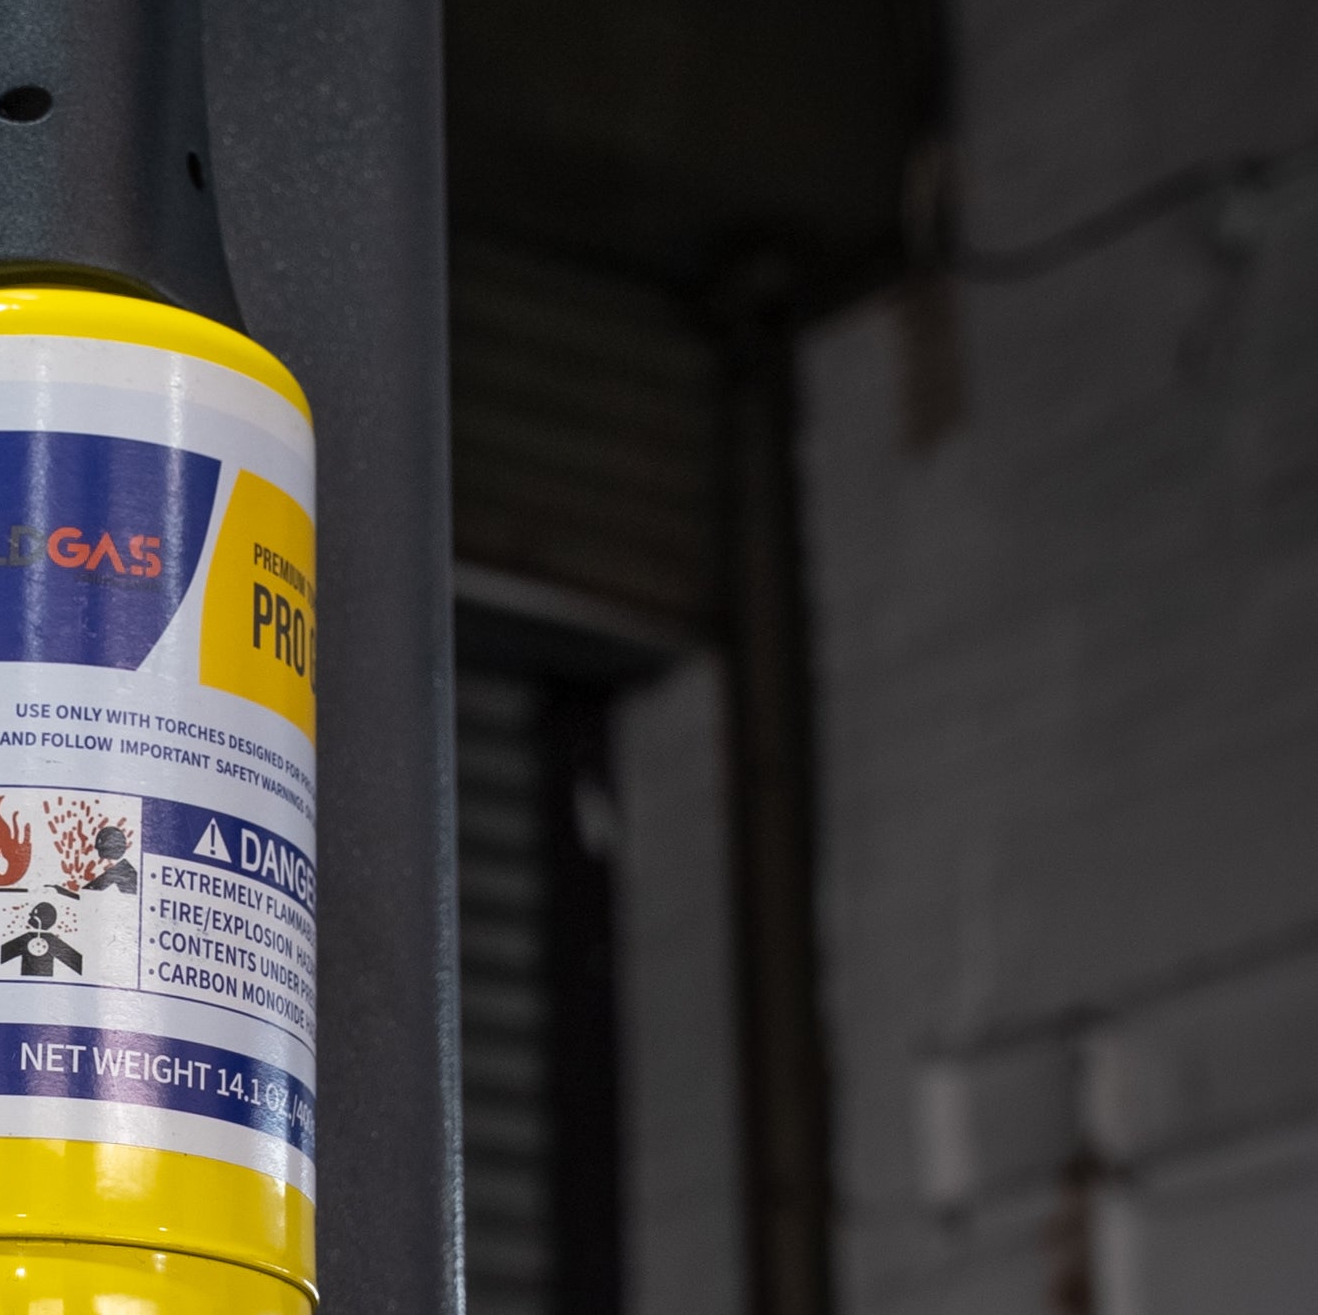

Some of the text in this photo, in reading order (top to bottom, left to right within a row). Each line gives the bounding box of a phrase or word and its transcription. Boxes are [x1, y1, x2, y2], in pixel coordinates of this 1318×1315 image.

[252, 581, 305, 677] PRO
[0, 731, 37, 747] AND
[41, 732, 113, 752] FOLLOW
[120, 739, 211, 770] IMPORTANT
[216, 758, 260, 786] SAFETY
[261, 775, 304, 813] WARNINGS
[15, 703, 301, 782] USE ONLY WITH TORCHES DESIGNED FOR
[162, 866, 263, 910] EXTREMELY
[241, 828, 317, 911] DANGE
[159, 930, 256, 972] CONTENTS
[260, 955, 300, 995] UNDER
[160, 898, 293, 960] FIRE/EXPLOSION
[158, 961, 237, 998] CARBON
[242, 981, 305, 1029] MONOXIDE
[21, 1042, 86, 1073] NET
[93, 1046, 211, 1091] WEIGHT
[216, 1068, 261, 1106] 14.1
